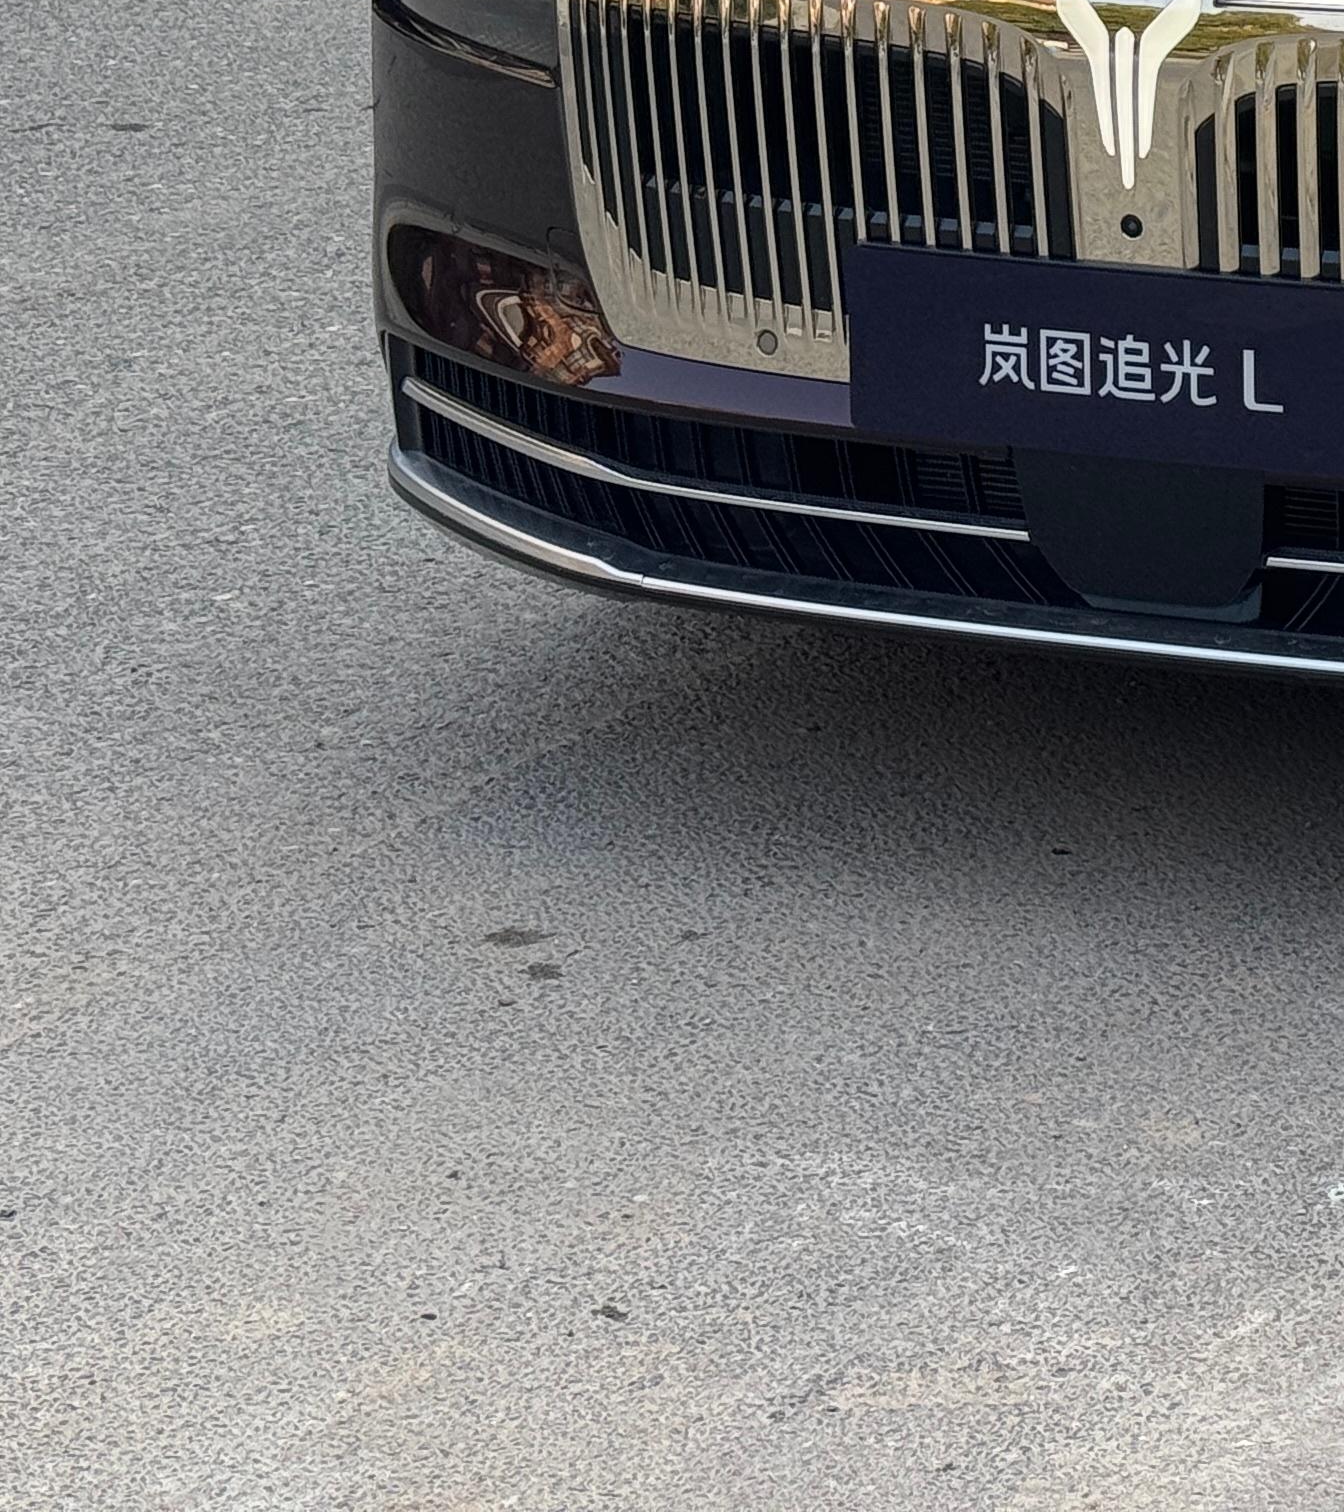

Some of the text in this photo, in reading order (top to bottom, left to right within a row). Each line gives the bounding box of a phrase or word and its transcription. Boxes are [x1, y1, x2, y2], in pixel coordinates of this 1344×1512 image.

[978, 324, 1284, 413] 岚图追光 L
